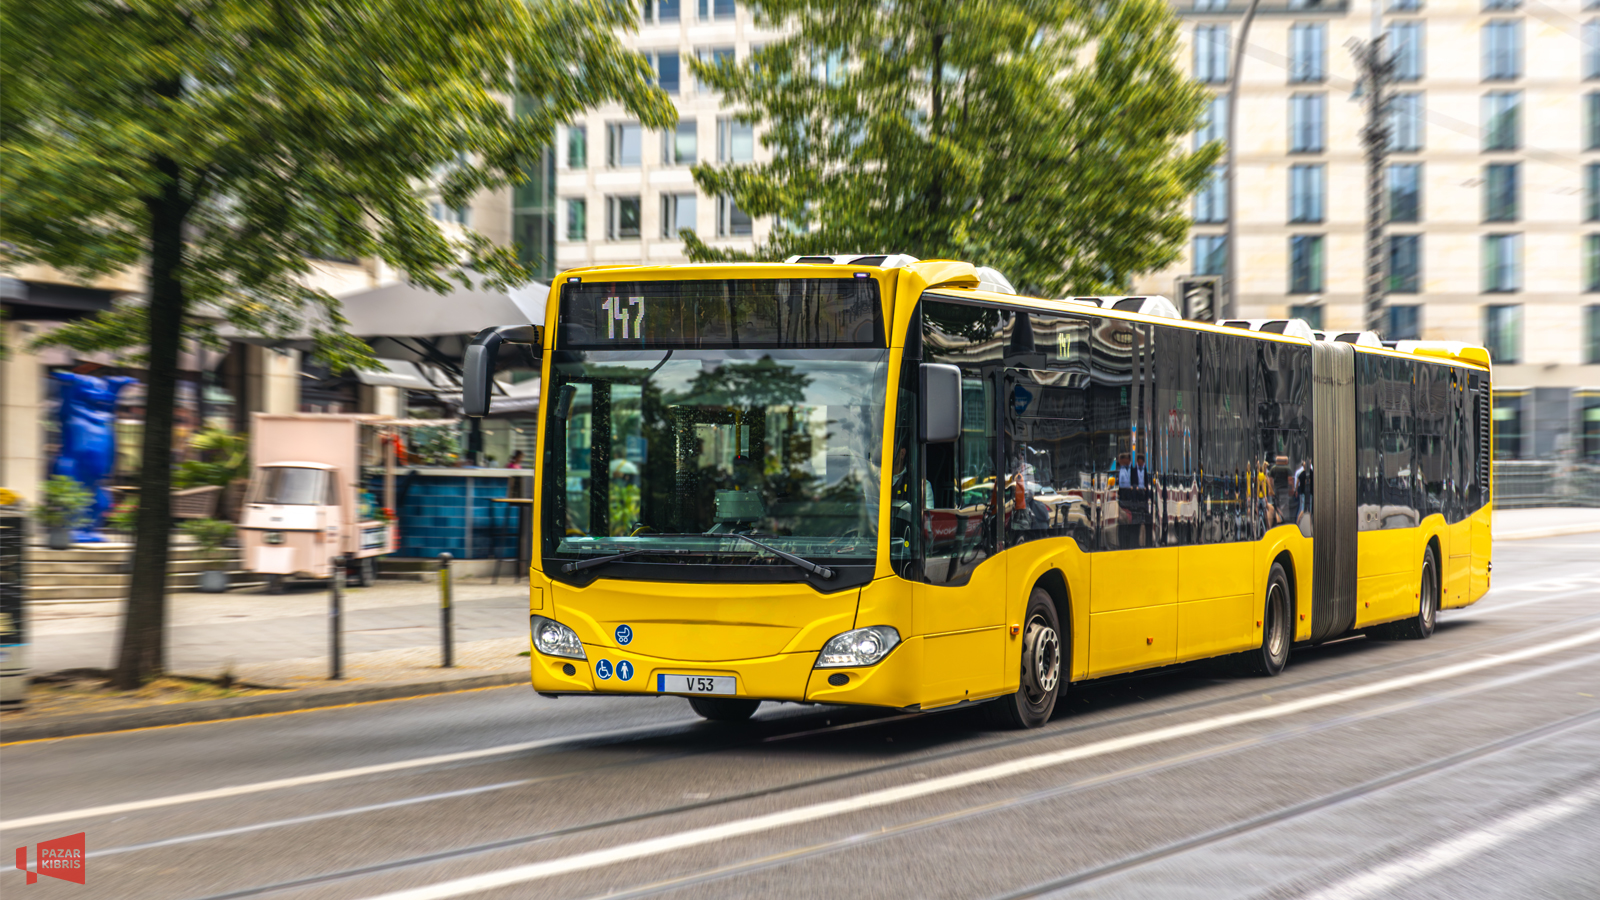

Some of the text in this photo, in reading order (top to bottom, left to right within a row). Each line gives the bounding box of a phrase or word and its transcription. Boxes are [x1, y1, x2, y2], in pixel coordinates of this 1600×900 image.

[602, 296, 645, 339] 147
[1058, 332, 1070, 357] 147
[686, 677, 714, 692] V 53
